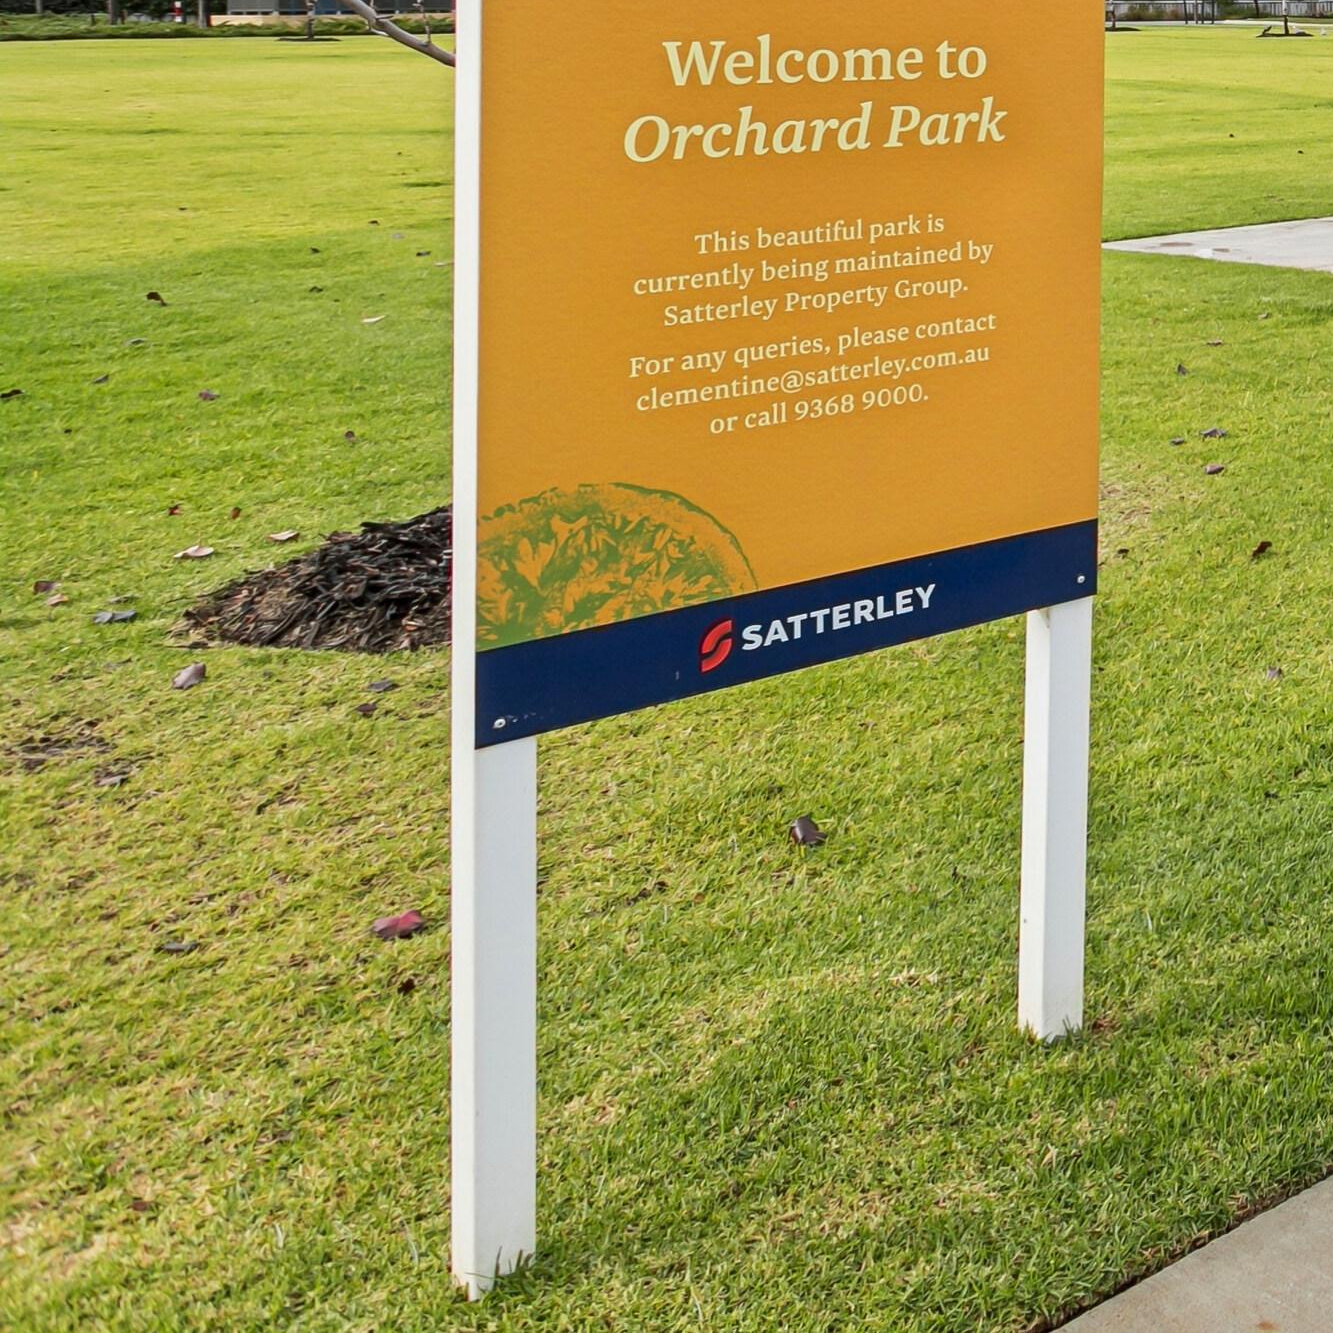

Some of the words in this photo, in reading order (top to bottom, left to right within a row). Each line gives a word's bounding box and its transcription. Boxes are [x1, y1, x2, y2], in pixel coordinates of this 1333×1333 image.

[662, 33, 924, 86] Welcome
[936, 41, 987, 80] to
[623, 100, 872, 163] Orchard
[884, 97, 1008, 149] Park
[694, 230, 749, 254] This
[757, 220, 863, 249] beautiful
[869, 216, 920, 242] park
[927, 214, 944, 232] is
[634, 263, 754, 295] currently
[761, 257, 829, 282] being
[835, 243, 962, 273] maintained
[967, 240, 994, 264] by
[663, 295, 777, 326] Satterley
[785, 282, 888, 315] Property
[894, 276, 968, 299] Group.
[629, 357, 673, 378] For
[680, 351, 727, 372] any
[734, 335, 831, 364] queries,
[838, 326, 910, 354] please
[915, 313, 997, 339] contact
[636, 346, 989, 411] clementine@satterley.com.au
[709, 415, 737, 434] or
[744, 403, 787, 428] call
[794, 394, 854, 421] 9368
[861, 384, 929, 410] 9000.
[741, 584, 936, 651] SATTERLEY
